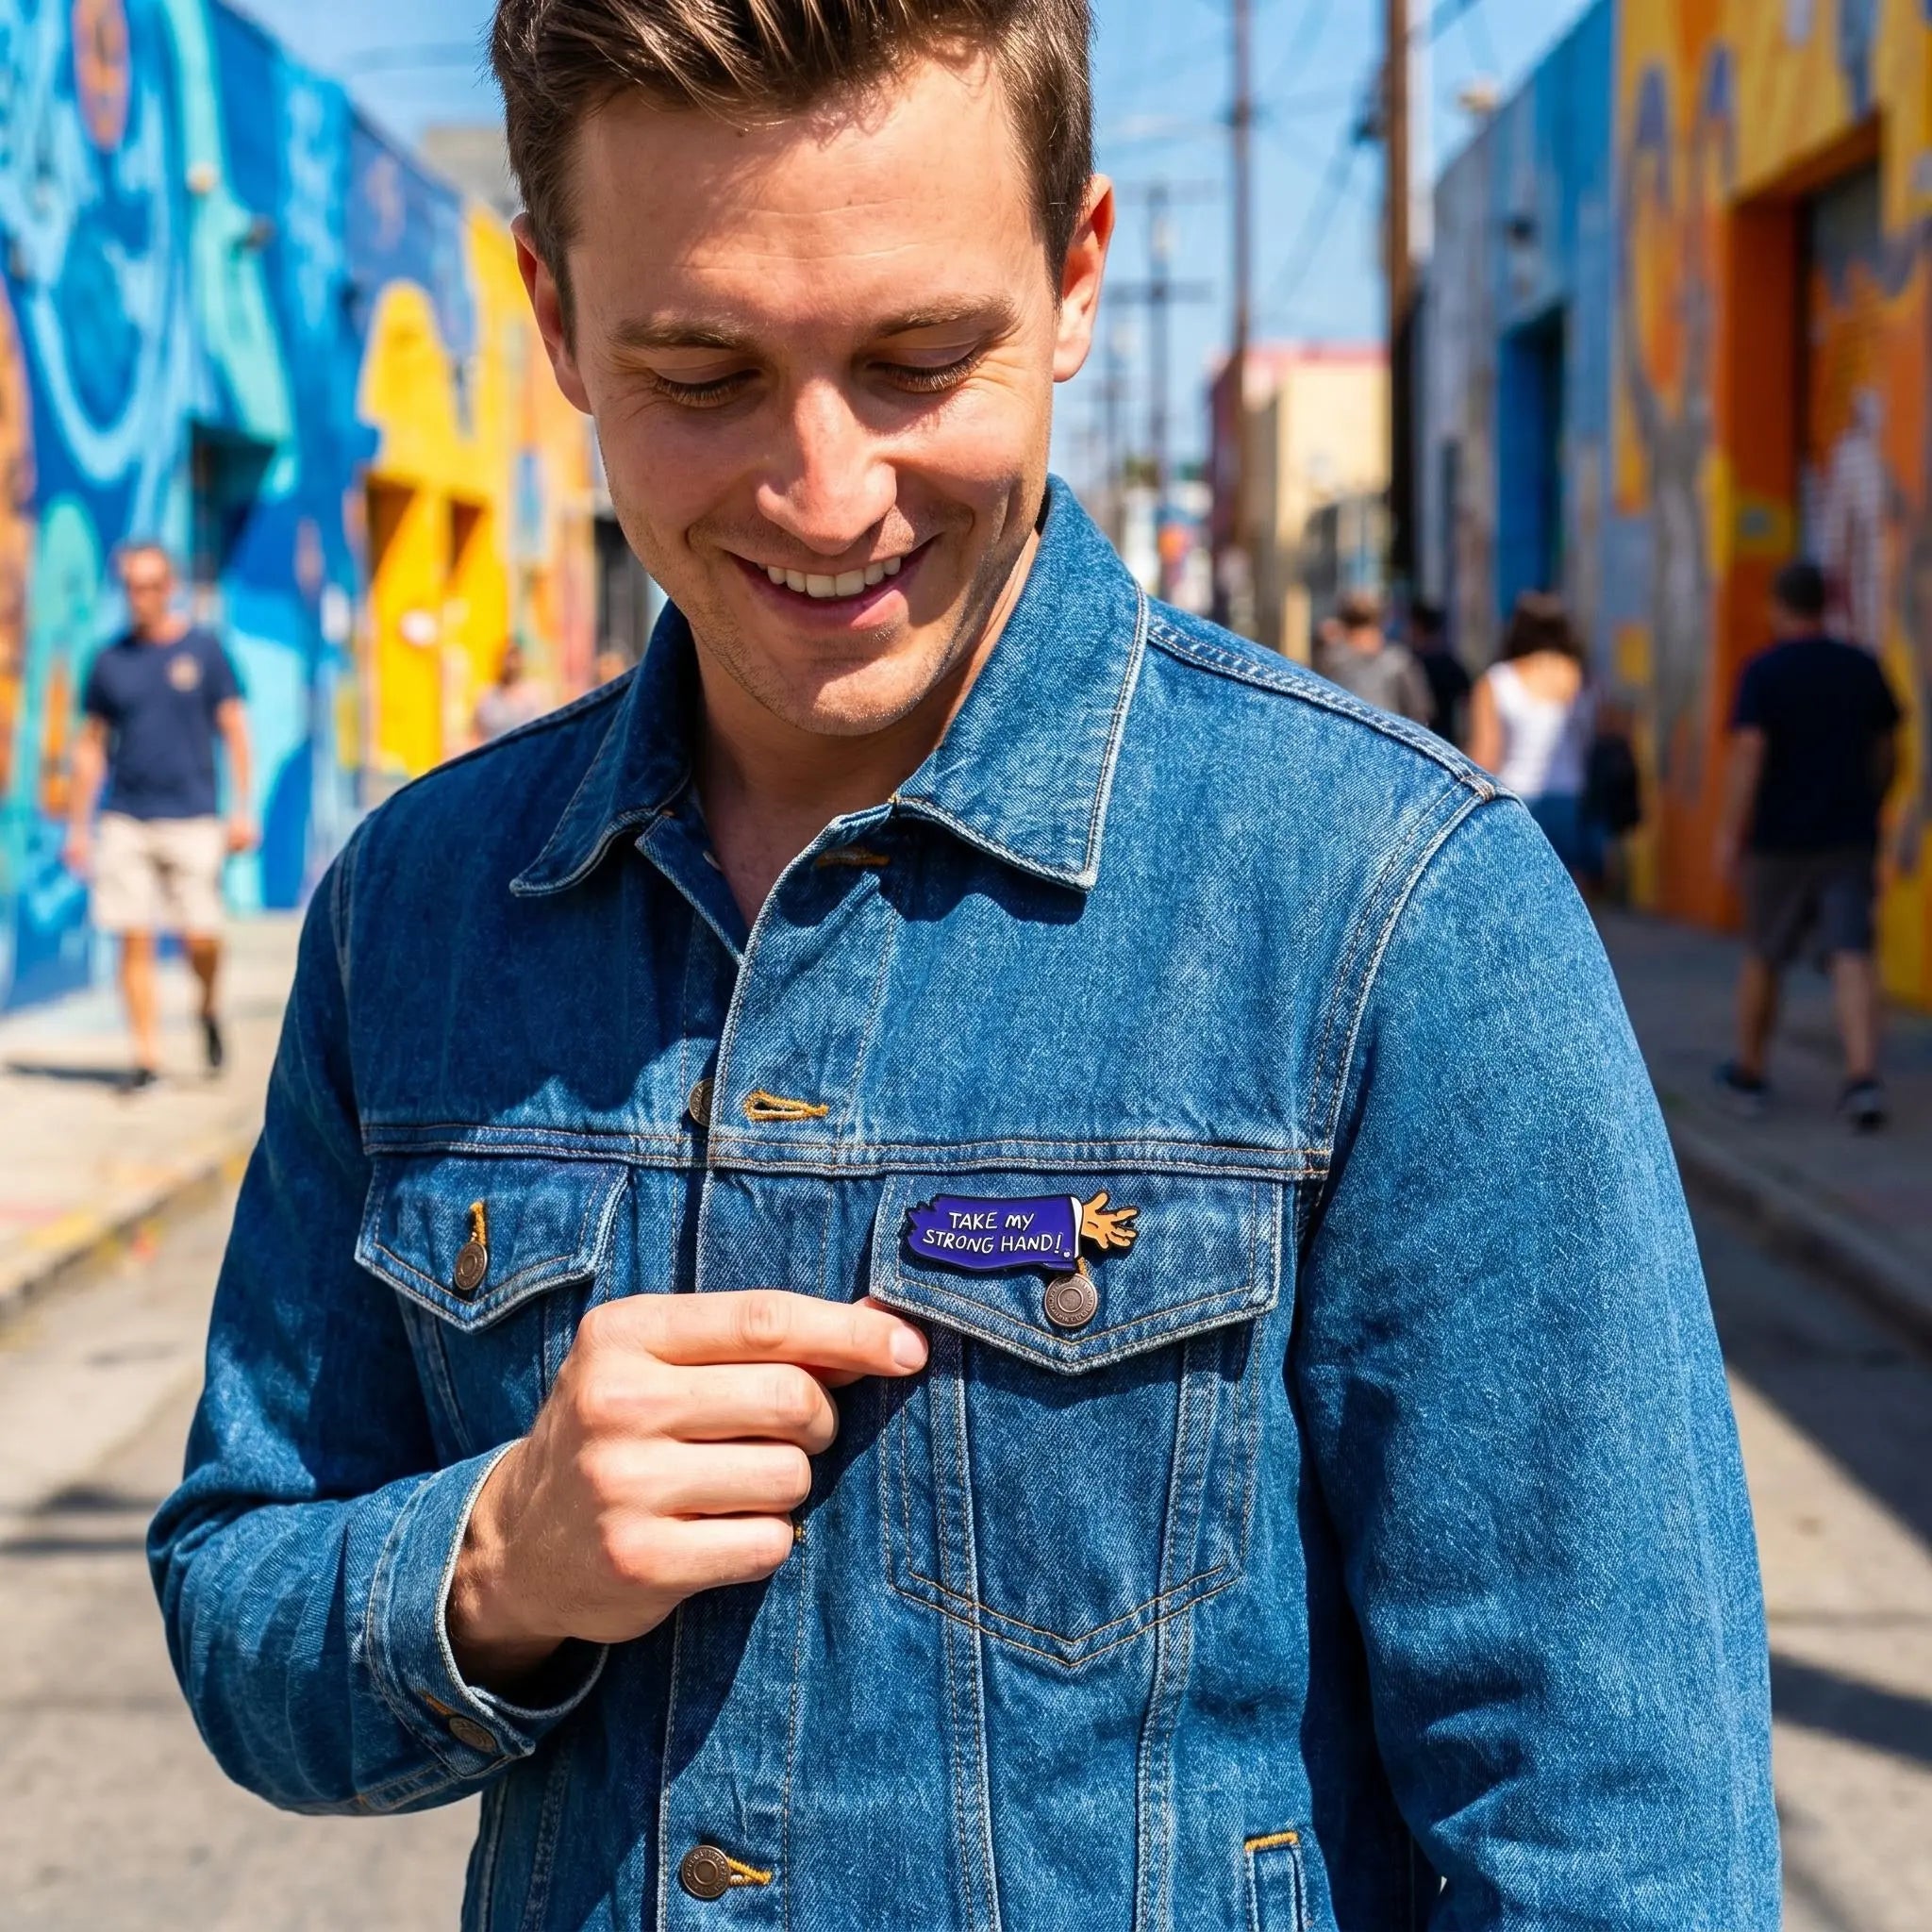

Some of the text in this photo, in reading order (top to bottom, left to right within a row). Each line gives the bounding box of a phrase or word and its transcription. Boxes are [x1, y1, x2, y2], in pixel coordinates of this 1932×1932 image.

[949, 1211, 1035, 1231] TAKE MY
[923, 1229, 1062, 1254] STRONG HAND!
